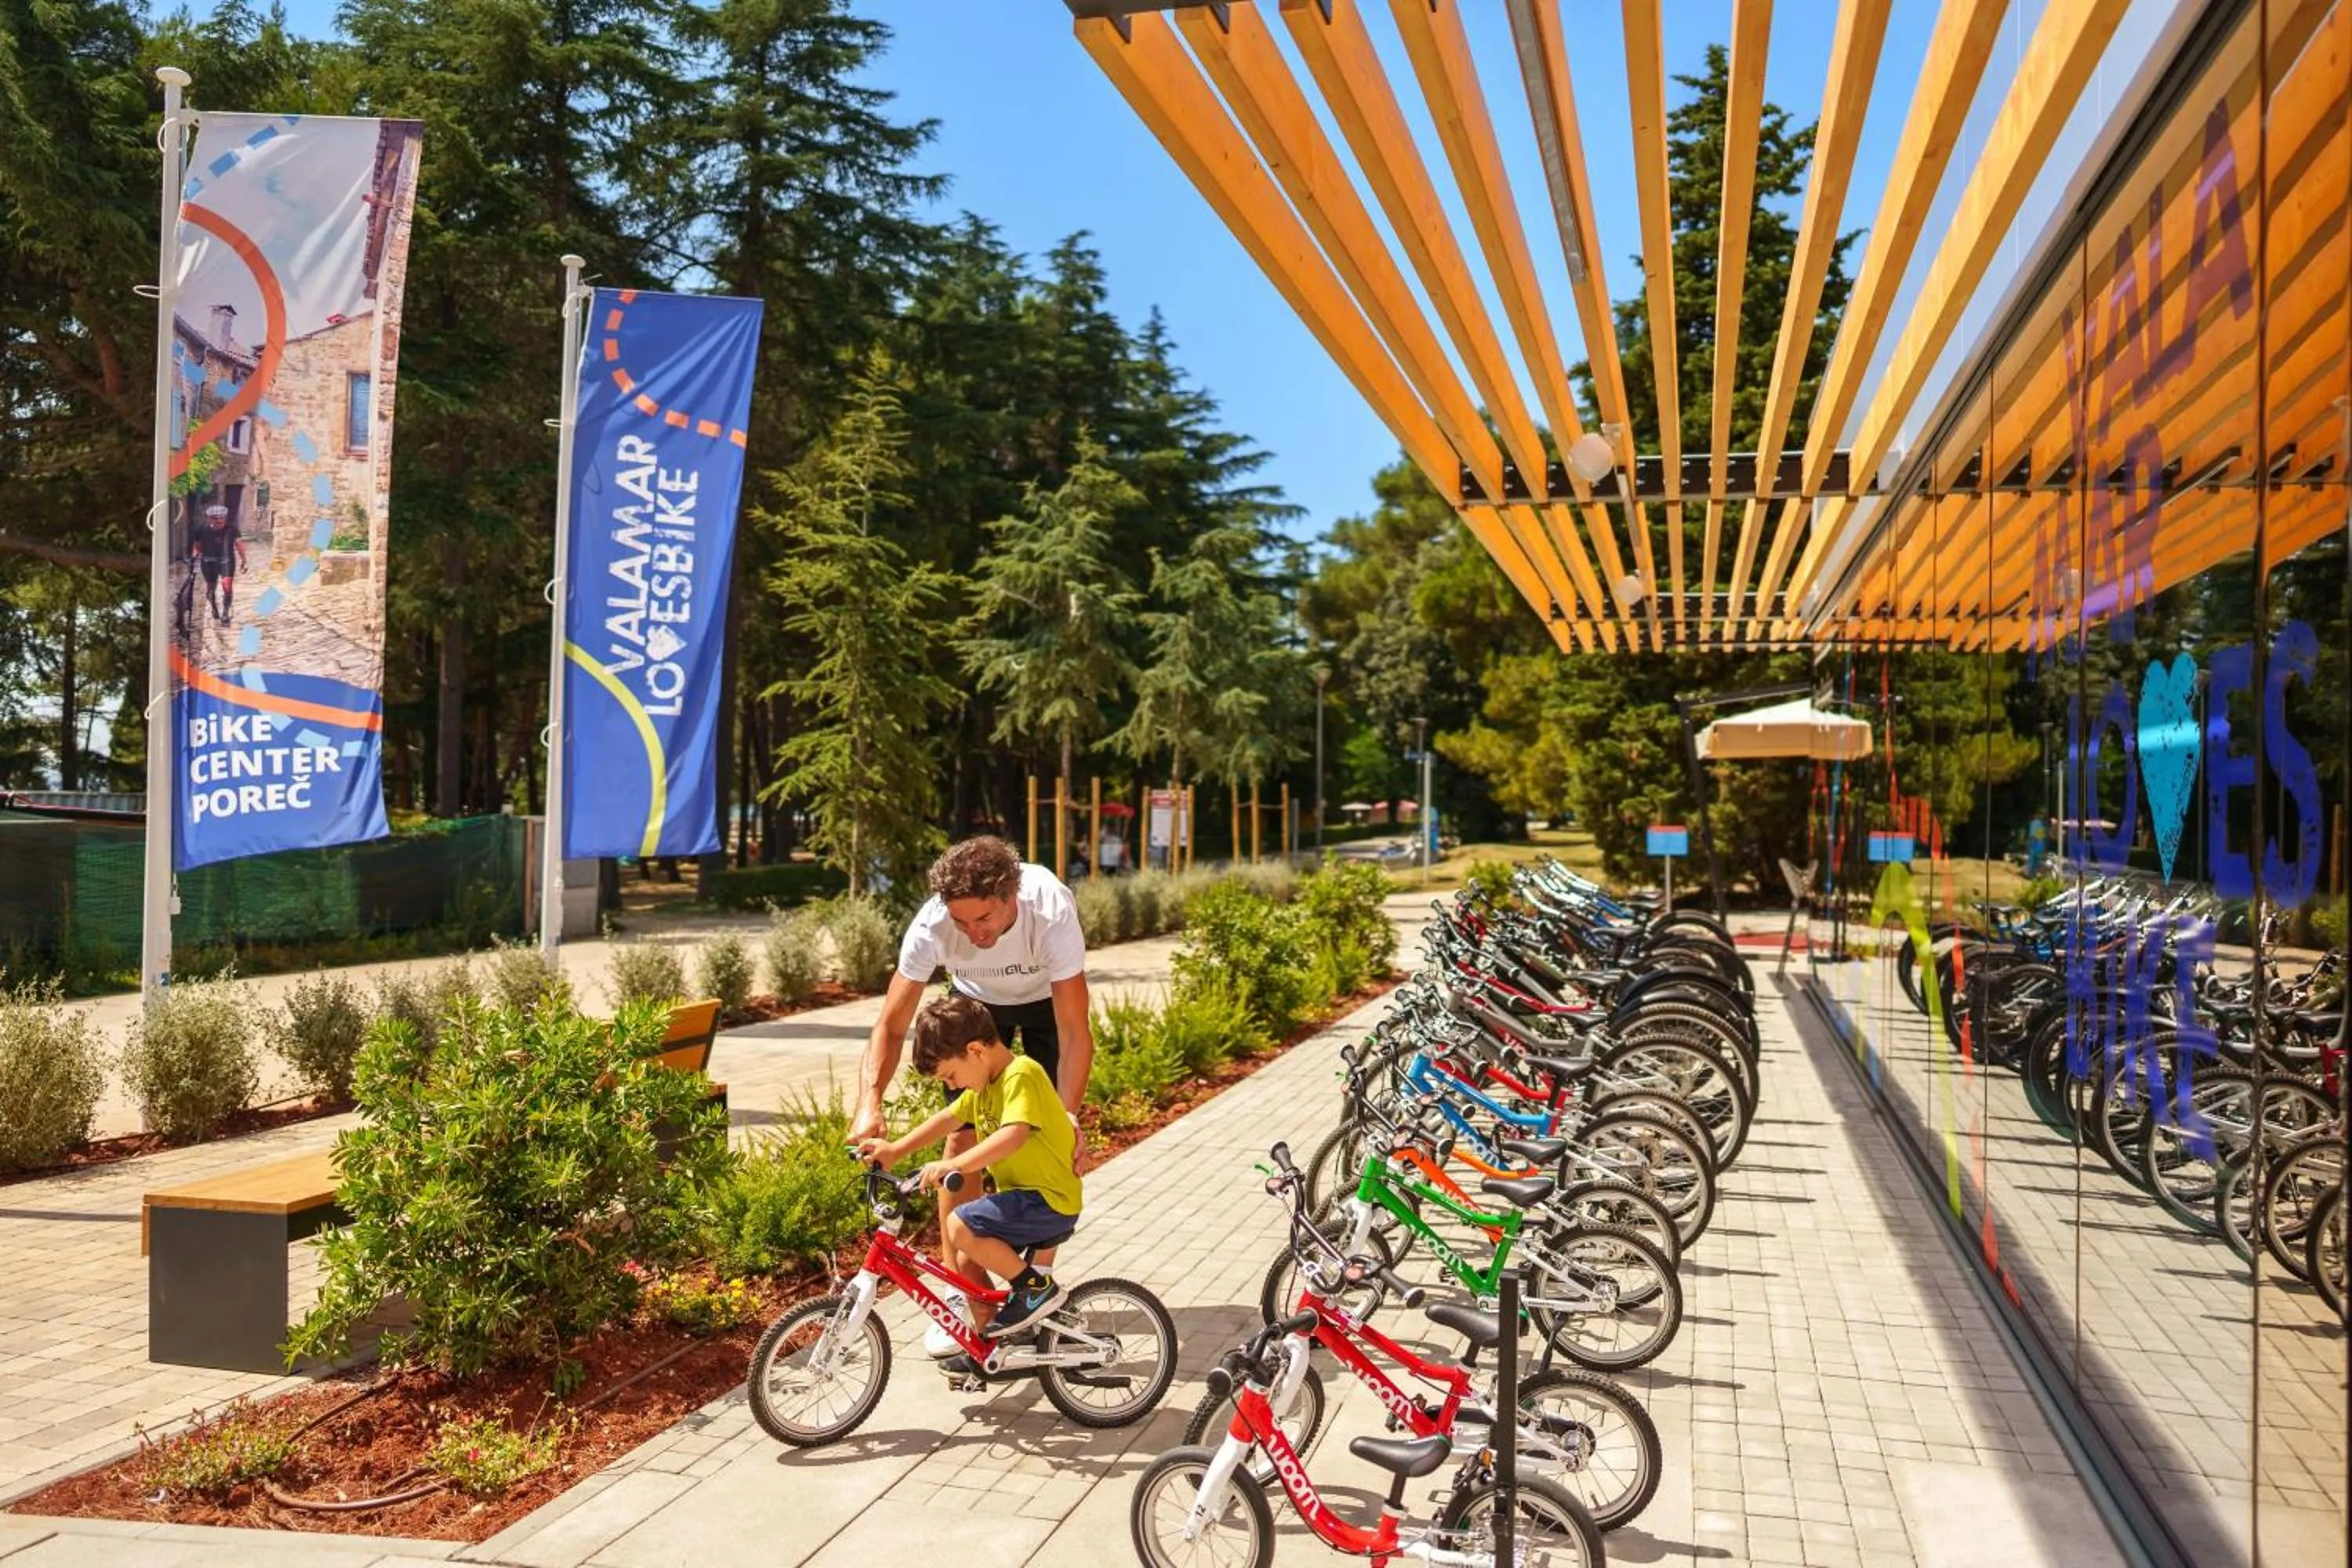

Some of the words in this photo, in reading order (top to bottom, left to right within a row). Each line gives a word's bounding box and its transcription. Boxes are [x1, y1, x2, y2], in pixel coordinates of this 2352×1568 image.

[604, 434, 658, 675] VALAMAR
[190, 746, 342, 785] CENTER
[191, 773, 313, 823] POREČ
[1410, 1223, 1465, 1273] woom
[912, 1289, 972, 1343] woom
[1345, 1359, 1414, 1424] woom
[1266, 1433, 1320, 1522] woom
